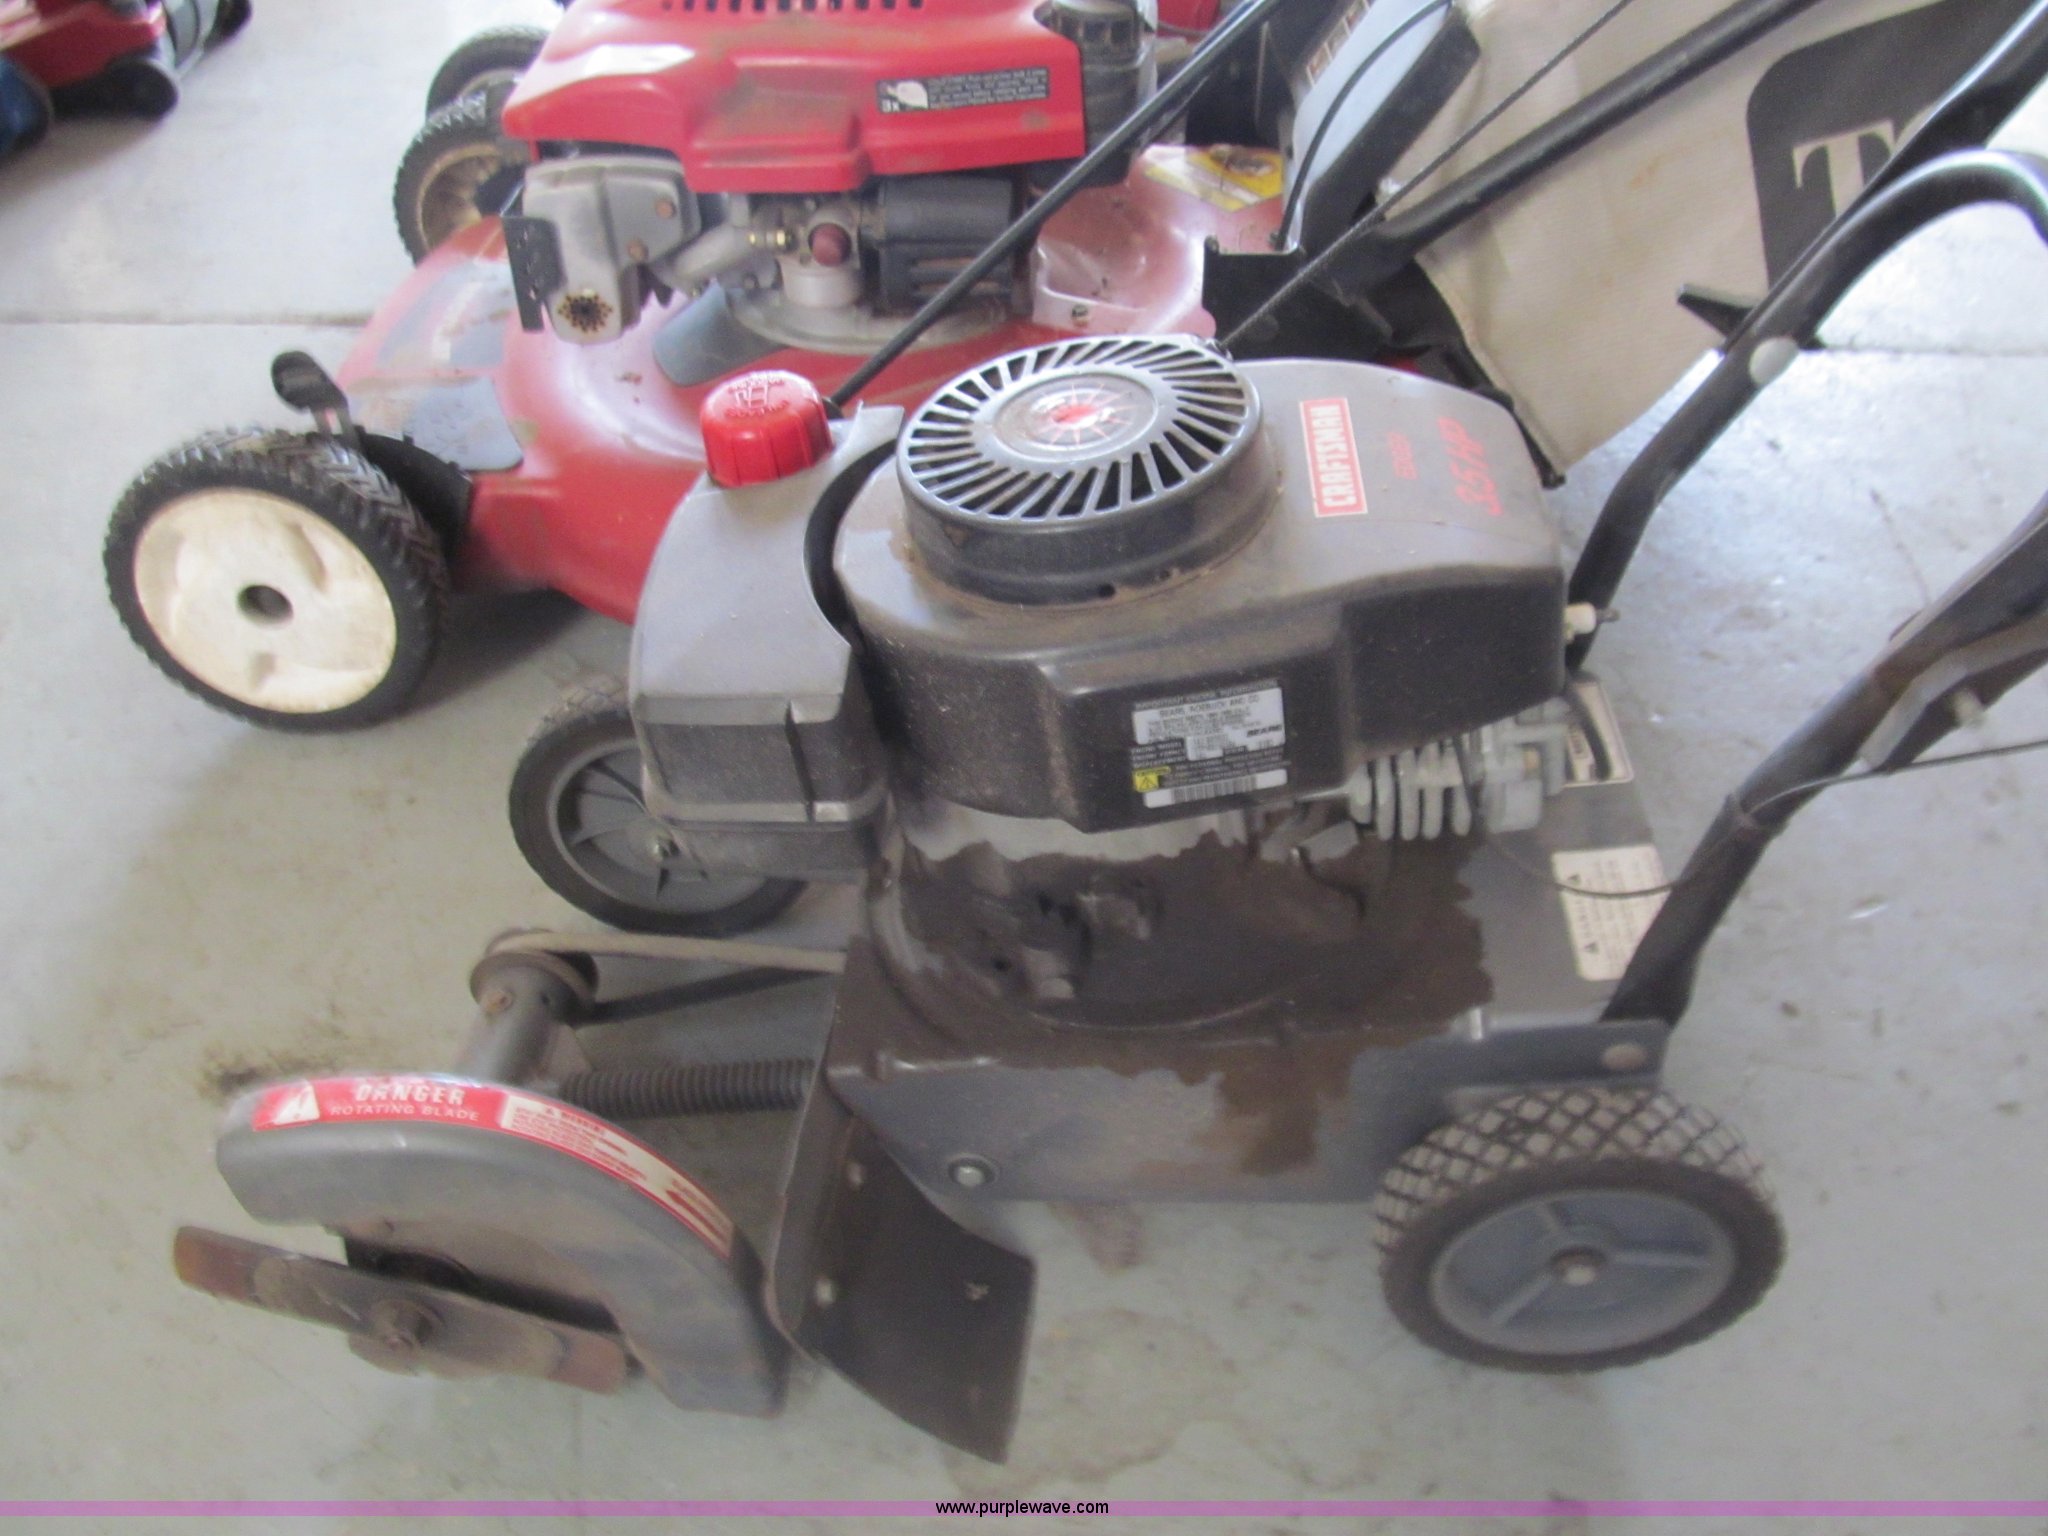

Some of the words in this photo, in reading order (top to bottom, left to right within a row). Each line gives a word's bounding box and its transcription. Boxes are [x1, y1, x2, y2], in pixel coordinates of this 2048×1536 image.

[1310, 405, 1357, 507] CRAFTSMAN
[355, 1082, 466, 1106] DANGER
[330, 1103, 415, 1117] ROTATING
[421, 1104, 480, 1122] BLADE
